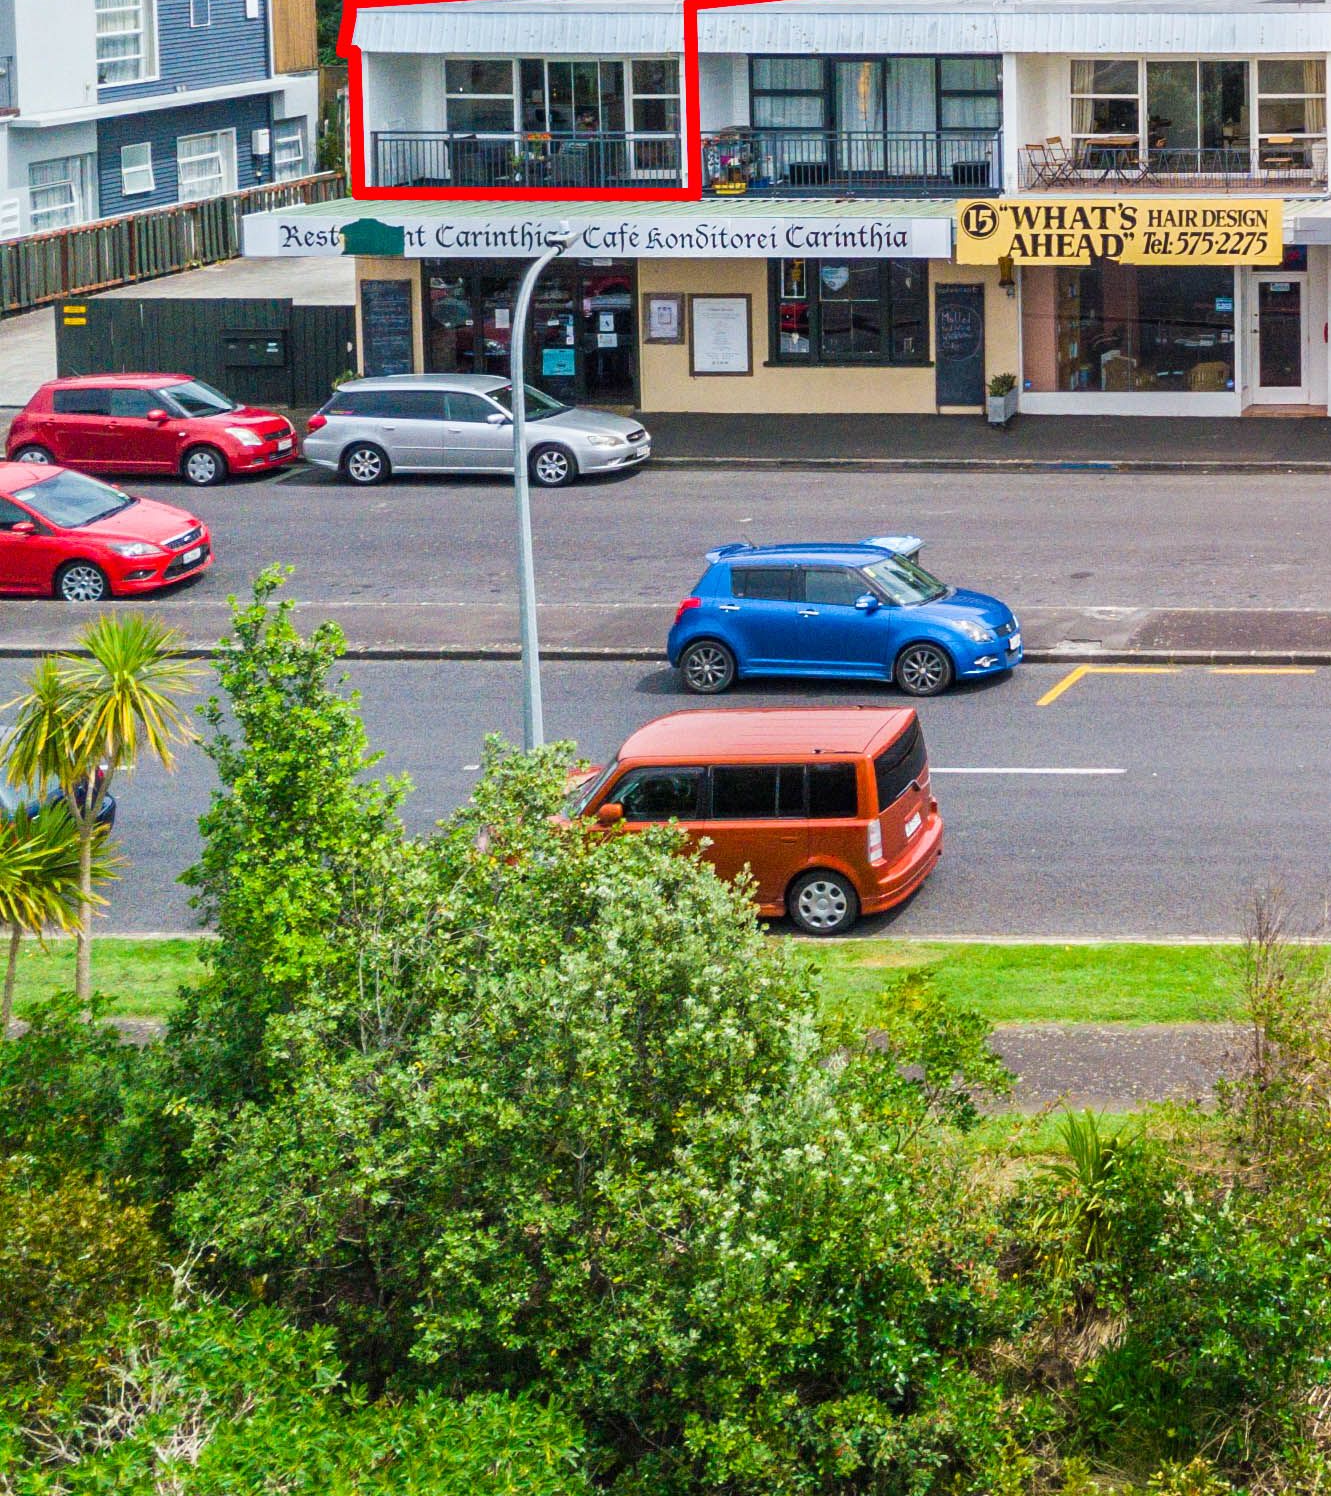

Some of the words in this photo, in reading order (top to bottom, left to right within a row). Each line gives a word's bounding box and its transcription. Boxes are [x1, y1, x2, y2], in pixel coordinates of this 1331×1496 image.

[968, 209, 994, 233] 15
[1148, 209, 1197, 229] HAIR
[1202, 209, 1269, 229] DESIGN
[280, 224, 426, 248] Restnt
[582, 224, 639, 252] Café
[785, 223, 908, 252] Carinthia
[1143, 232, 1173, 255] Tel:
